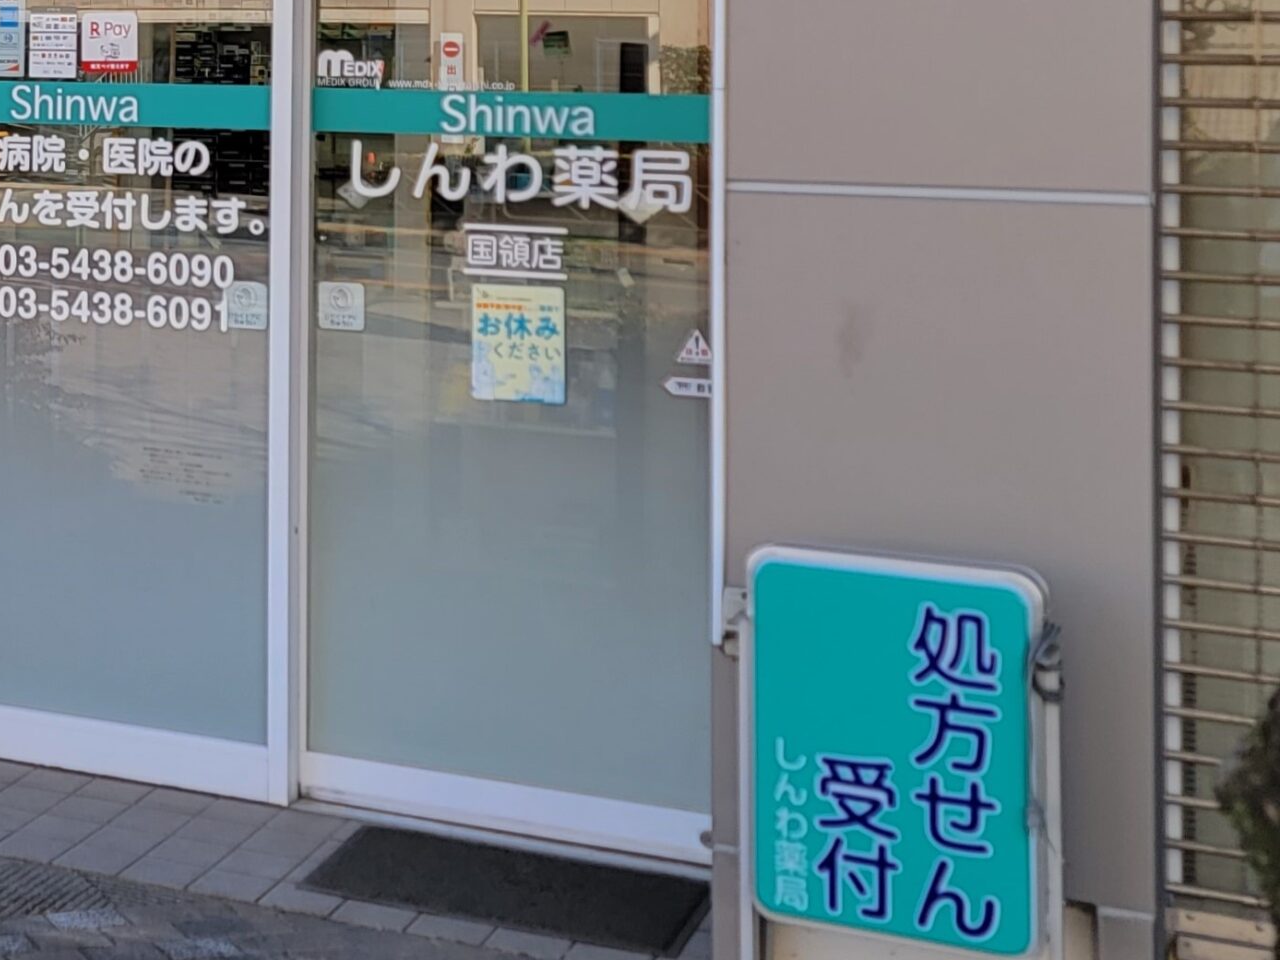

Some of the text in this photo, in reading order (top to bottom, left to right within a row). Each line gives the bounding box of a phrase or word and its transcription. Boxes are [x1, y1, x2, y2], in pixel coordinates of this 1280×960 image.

[104, 21, 131, 38] Pay
[317, 77, 381, 87] MEDIX GROU
[10, 84, 139, 123] Shinwa
[440, 93, 596, 137] Shinwa
[351, 139, 693, 214] しんわ薬局
[466, 235, 564, 270] 国領店
[477, 312, 560, 340] お休み
[494, 342, 562, 361] ください
[908, 600, 1002, 939] 処方せん
[774, 736, 809, 912] しんわ薬局
[815, 753, 902, 922] 受付
